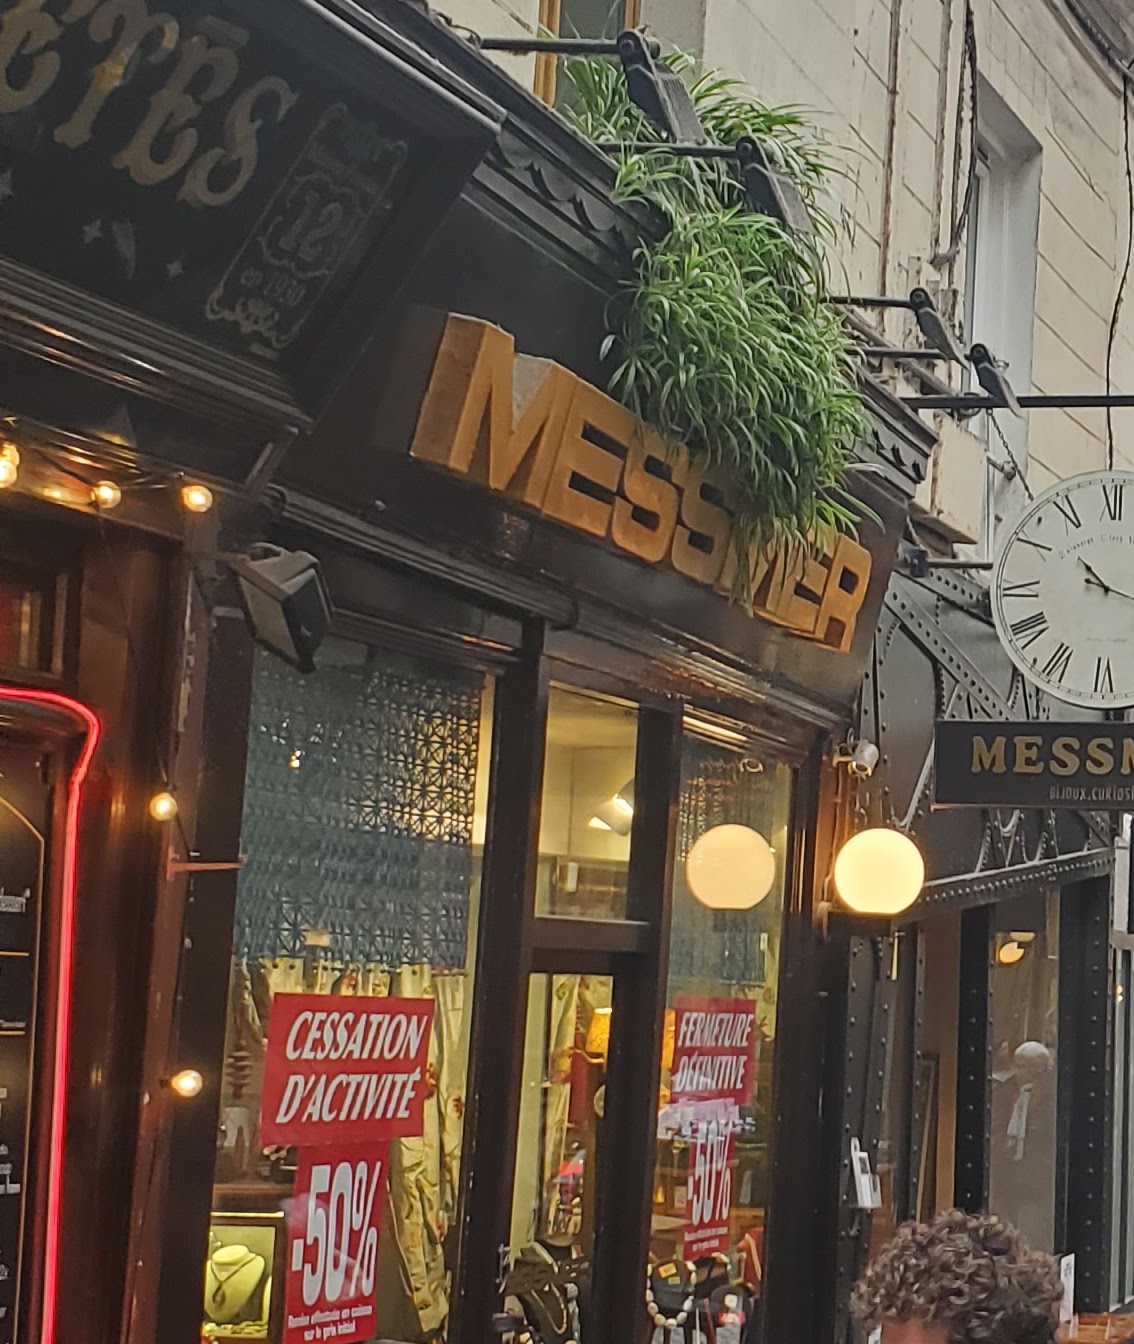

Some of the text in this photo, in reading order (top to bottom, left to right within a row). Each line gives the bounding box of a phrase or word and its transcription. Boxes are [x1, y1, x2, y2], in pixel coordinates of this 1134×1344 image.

[286, 1010, 428, 1061] CESSATION
[677, 1011, 755, 1048] FERMETURE
[275, 1065, 422, 1124] D'ACTIVITÉ
[675, 1050, 749, 1093] DÉFINITIVE
[291, 1160, 382, 1307] -50%
